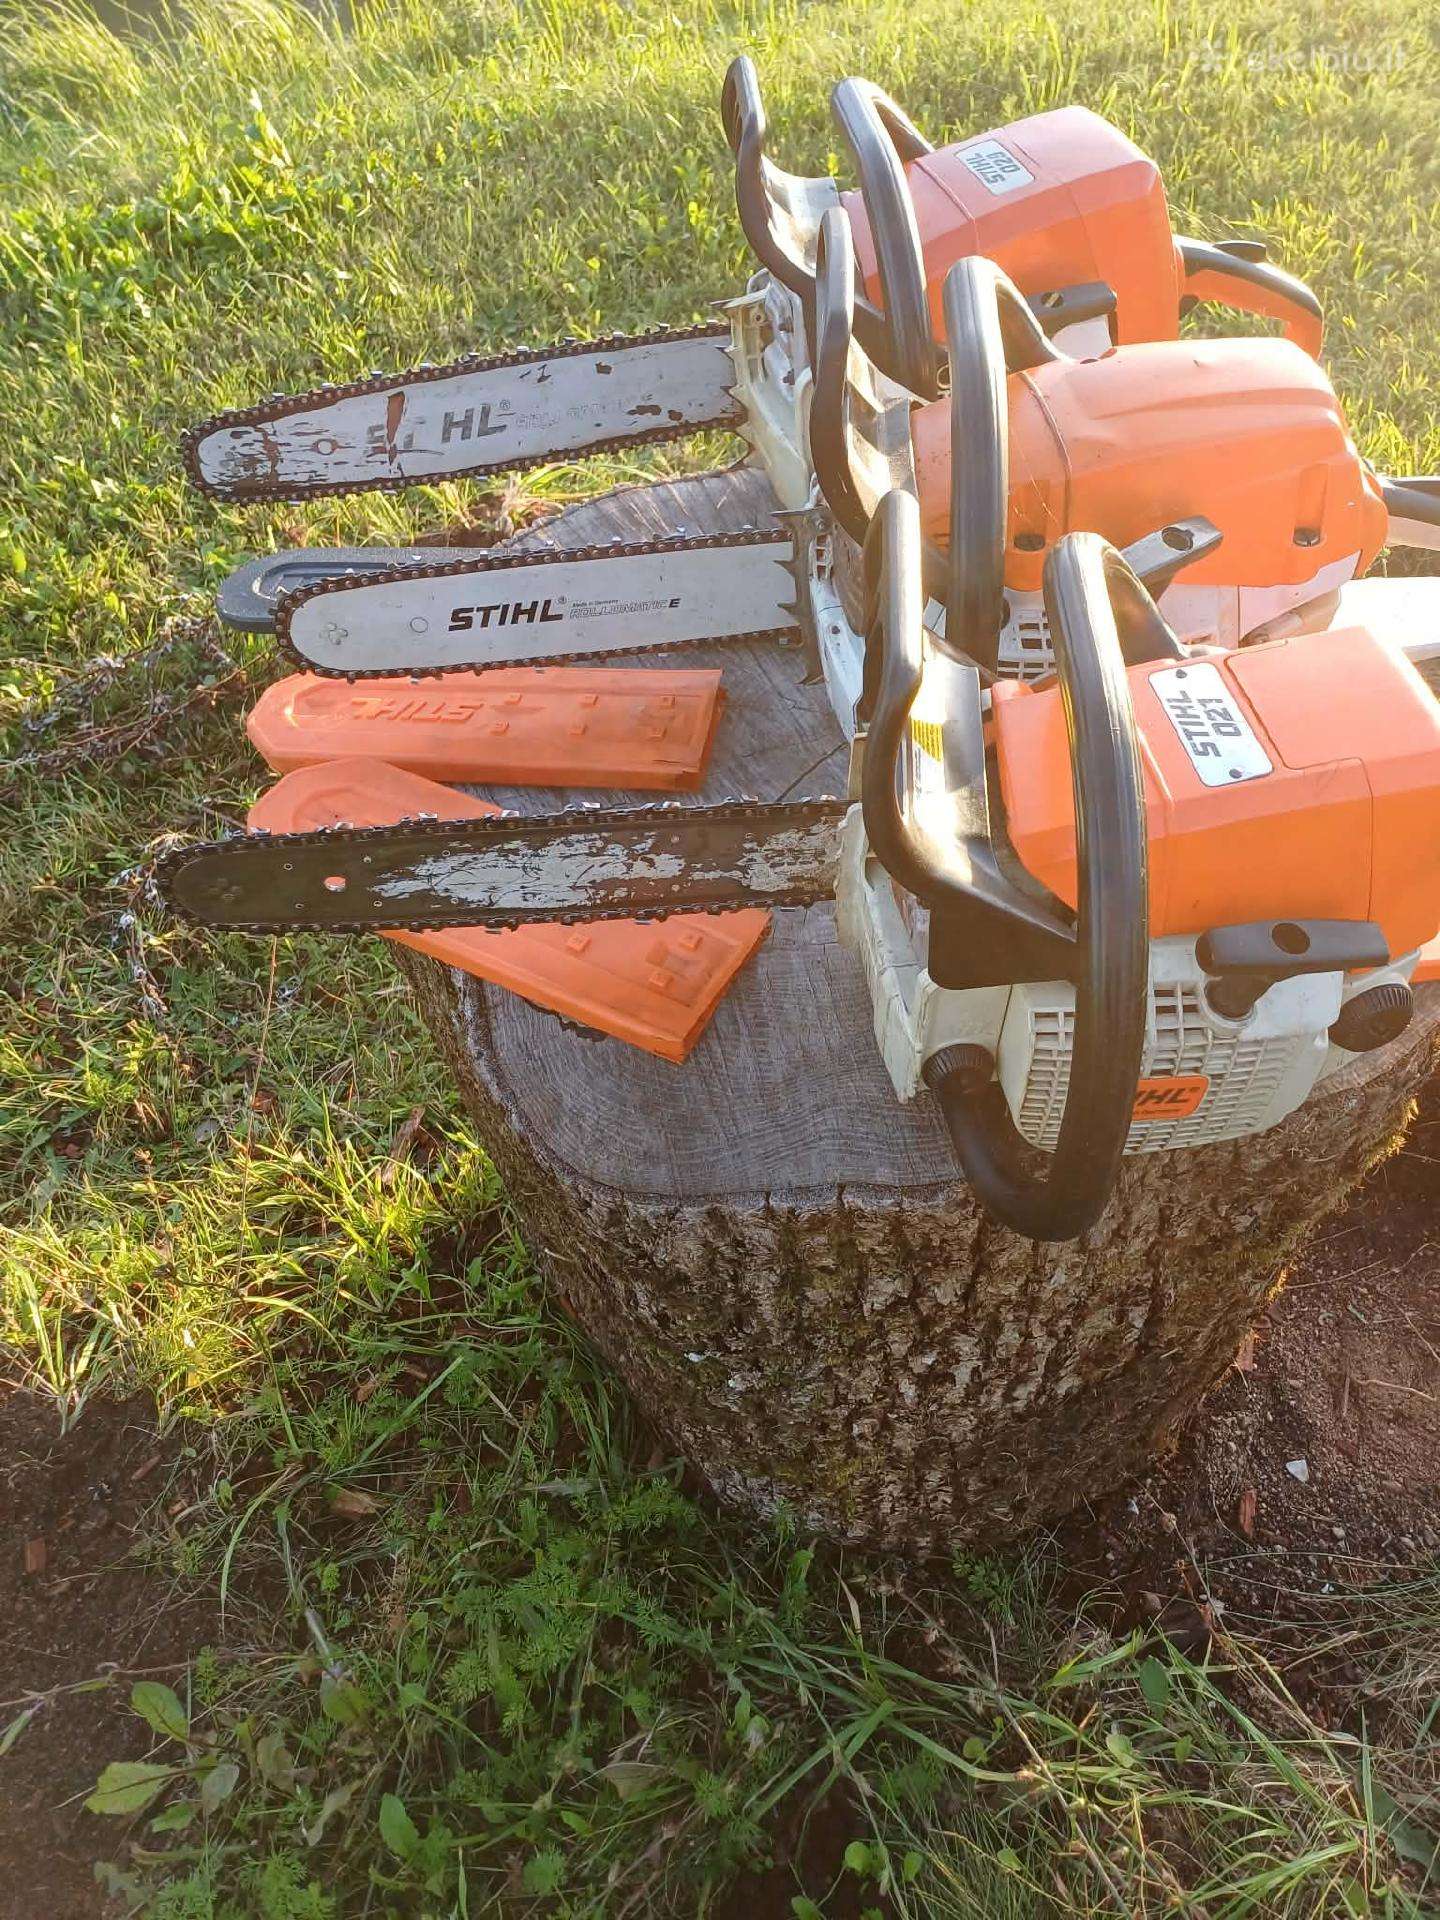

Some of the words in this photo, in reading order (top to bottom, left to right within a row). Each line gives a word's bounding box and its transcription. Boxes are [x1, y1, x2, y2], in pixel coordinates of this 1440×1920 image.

[966, 152, 1006, 184] STIHL
[448, 599, 564, 632] STIHL
[1165, 690, 1222, 758] STIHL
[1196, 698, 1242, 737] 021
